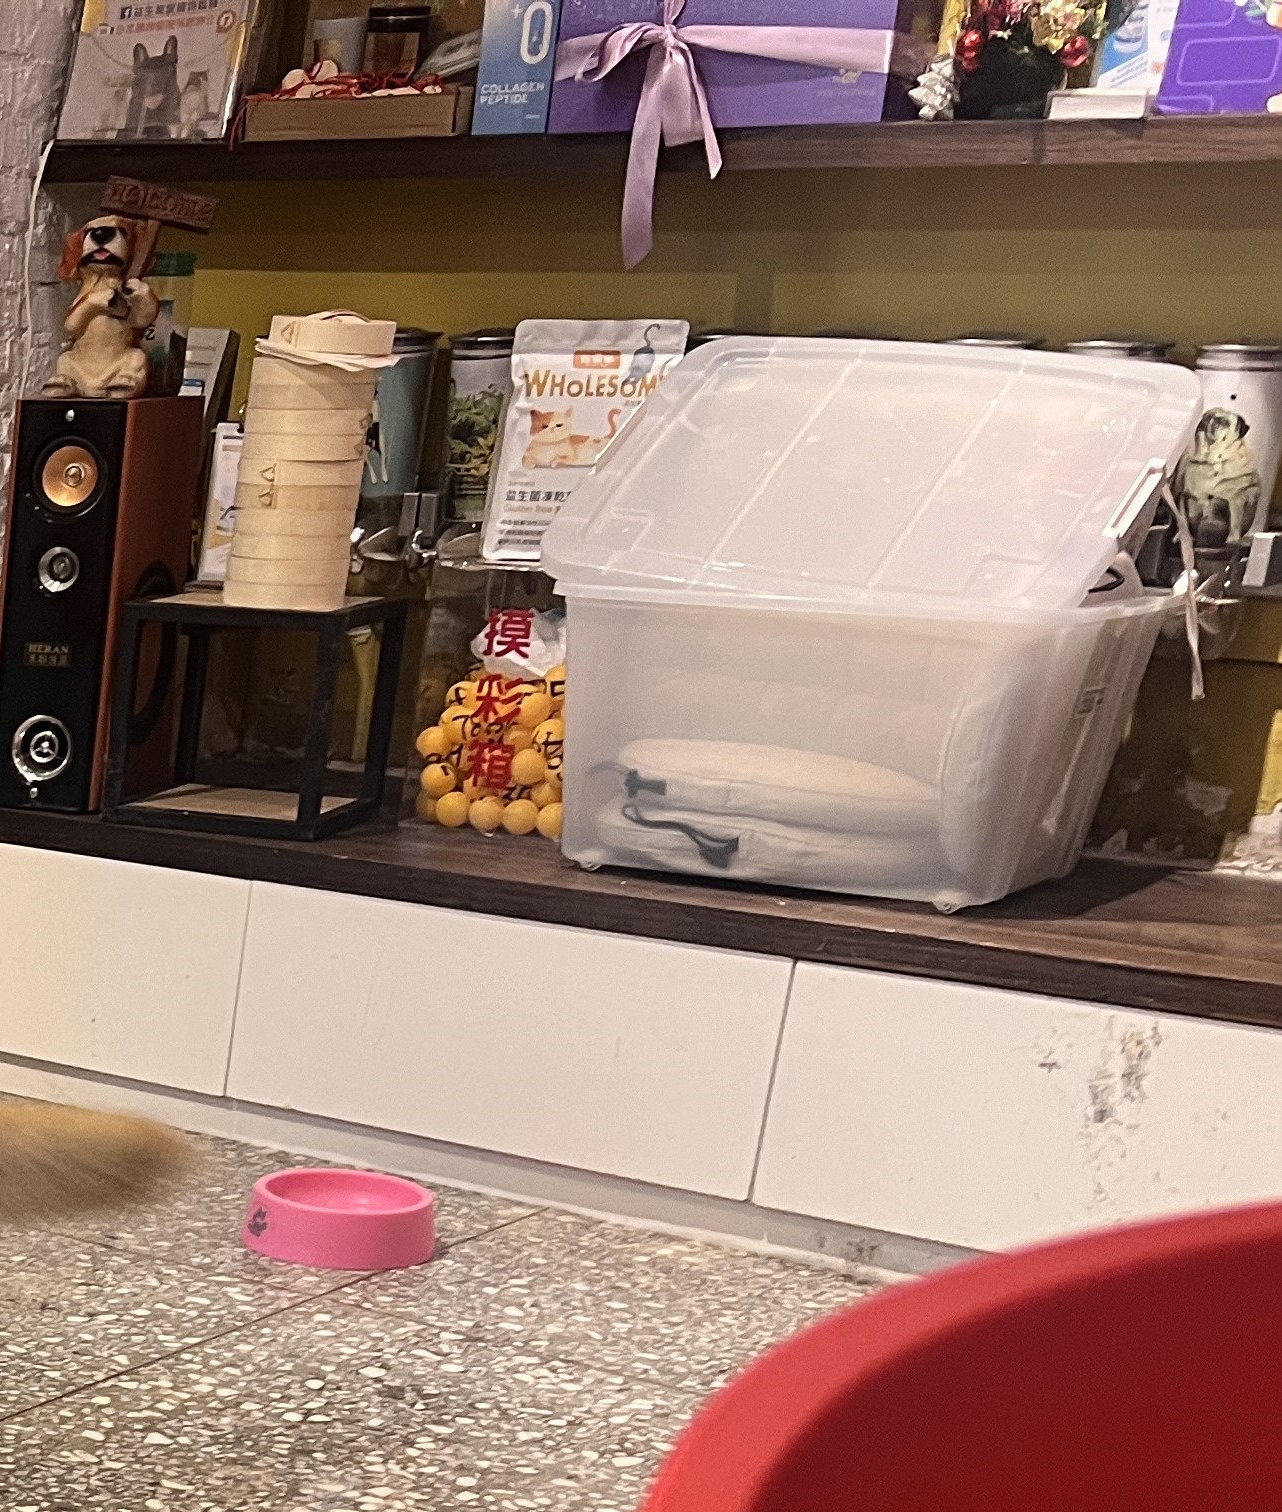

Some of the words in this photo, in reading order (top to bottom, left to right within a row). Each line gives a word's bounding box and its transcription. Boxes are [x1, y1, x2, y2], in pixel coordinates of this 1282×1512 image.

[480, 81, 545, 94] COLLAGEN
[479, 94, 529, 105] PEPTIDE
[524, 369, 664, 398] WHOLESOM
[465, 607, 536, 789] 摸彩箱
